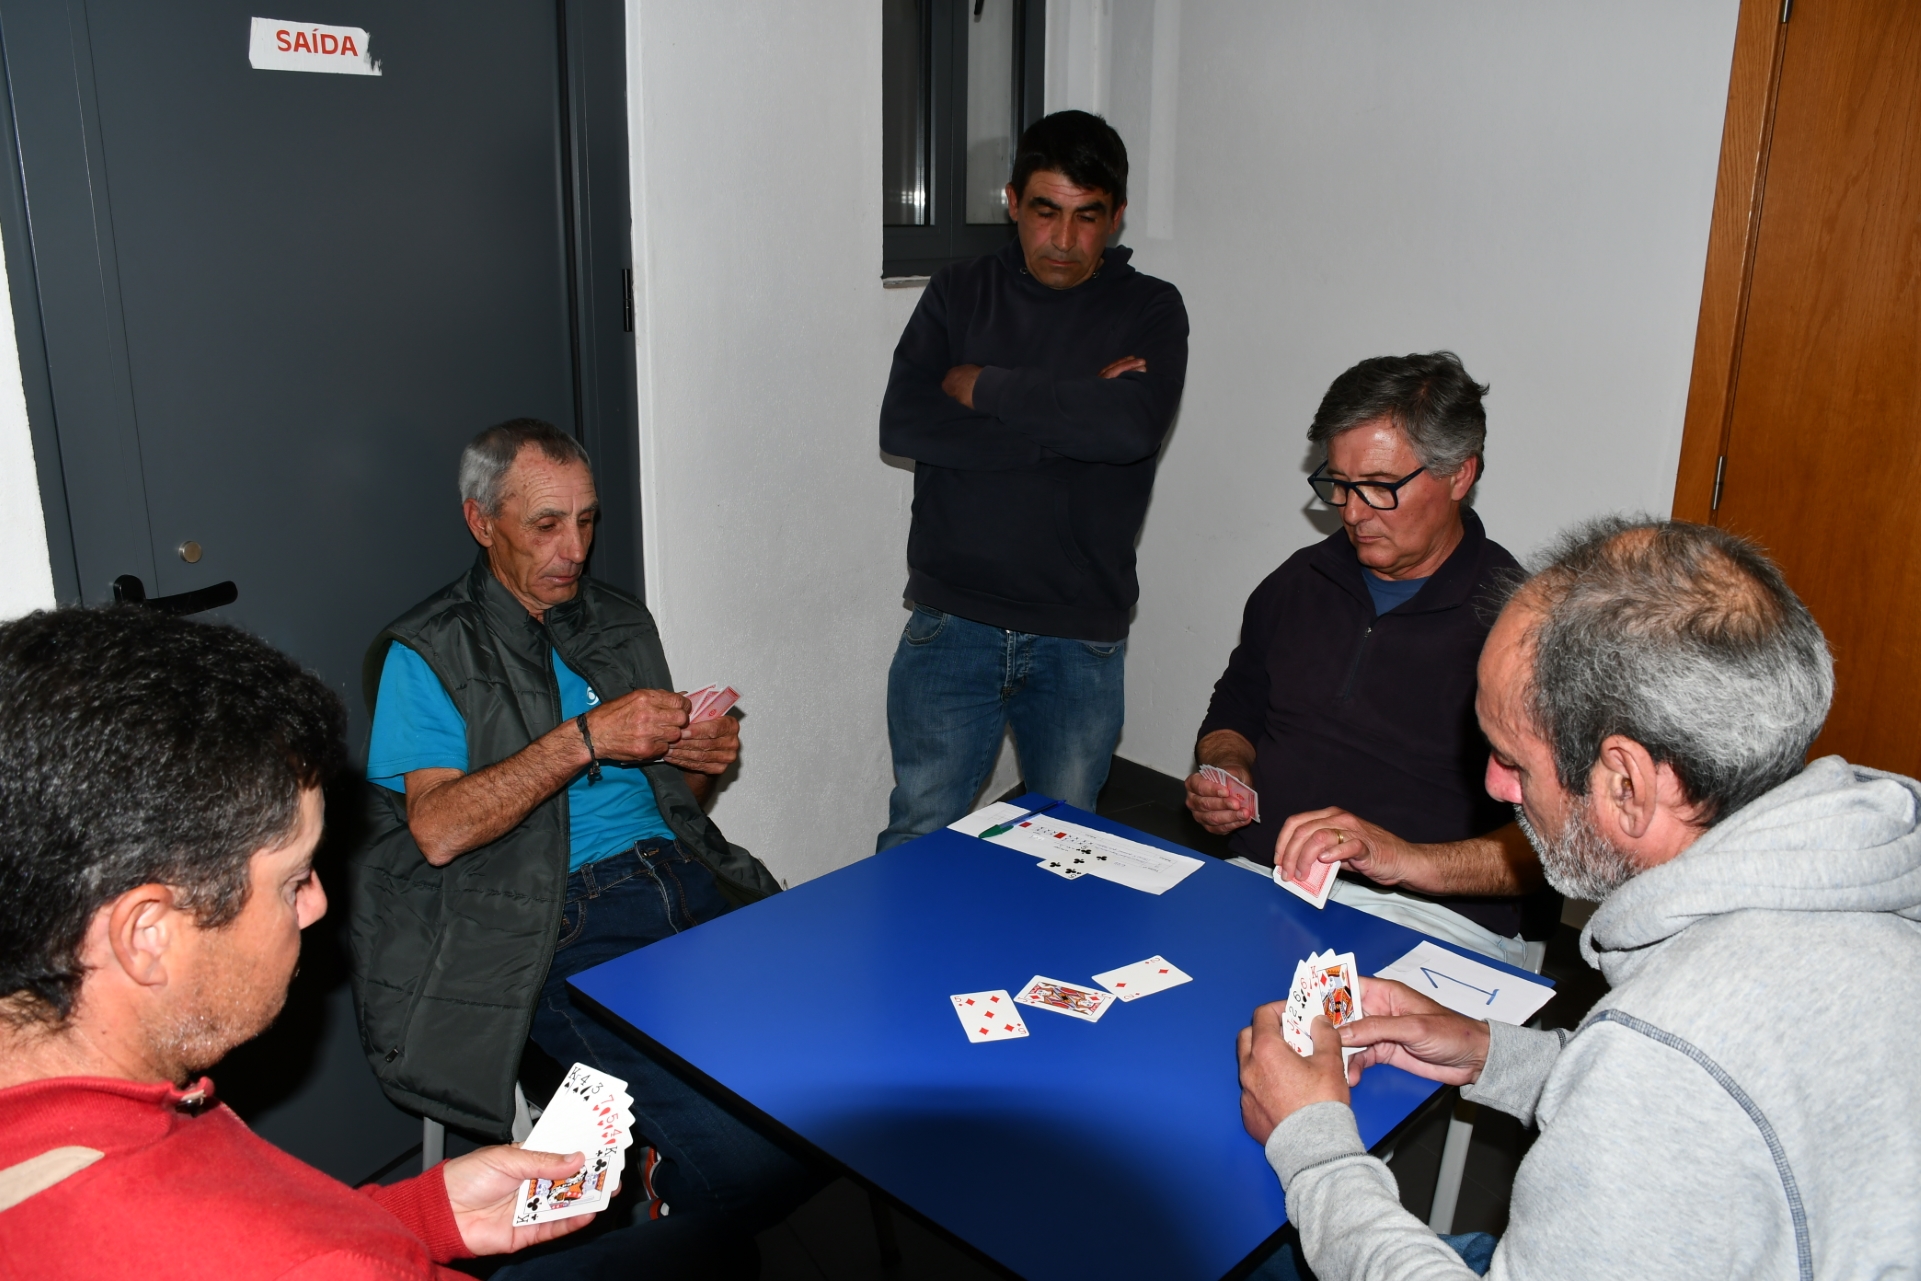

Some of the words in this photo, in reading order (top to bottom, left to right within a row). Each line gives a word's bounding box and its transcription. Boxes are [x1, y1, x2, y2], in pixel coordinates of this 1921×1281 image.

[276, 28, 358, 56] SAÍDA
[1310, 966, 1318, 979] K
[1300, 977, 1307, 990] 6
[1420, 966, 1500, 1005] 1
[1293, 990, 1301, 1003] 6
[1289, 1006, 1298, 1018] 2
[1287, 1019, 1295, 1031] J
[569, 1066, 581, 1081] K
[580, 1074, 591, 1086] 4
[591, 1082, 604, 1094] 3
[601, 1094, 615, 1104] 7
[606, 1113, 619, 1124] 5
[610, 1129, 622, 1137] 4
[604, 1146, 618, 1156] K
[516, 1214, 529, 1224] K
